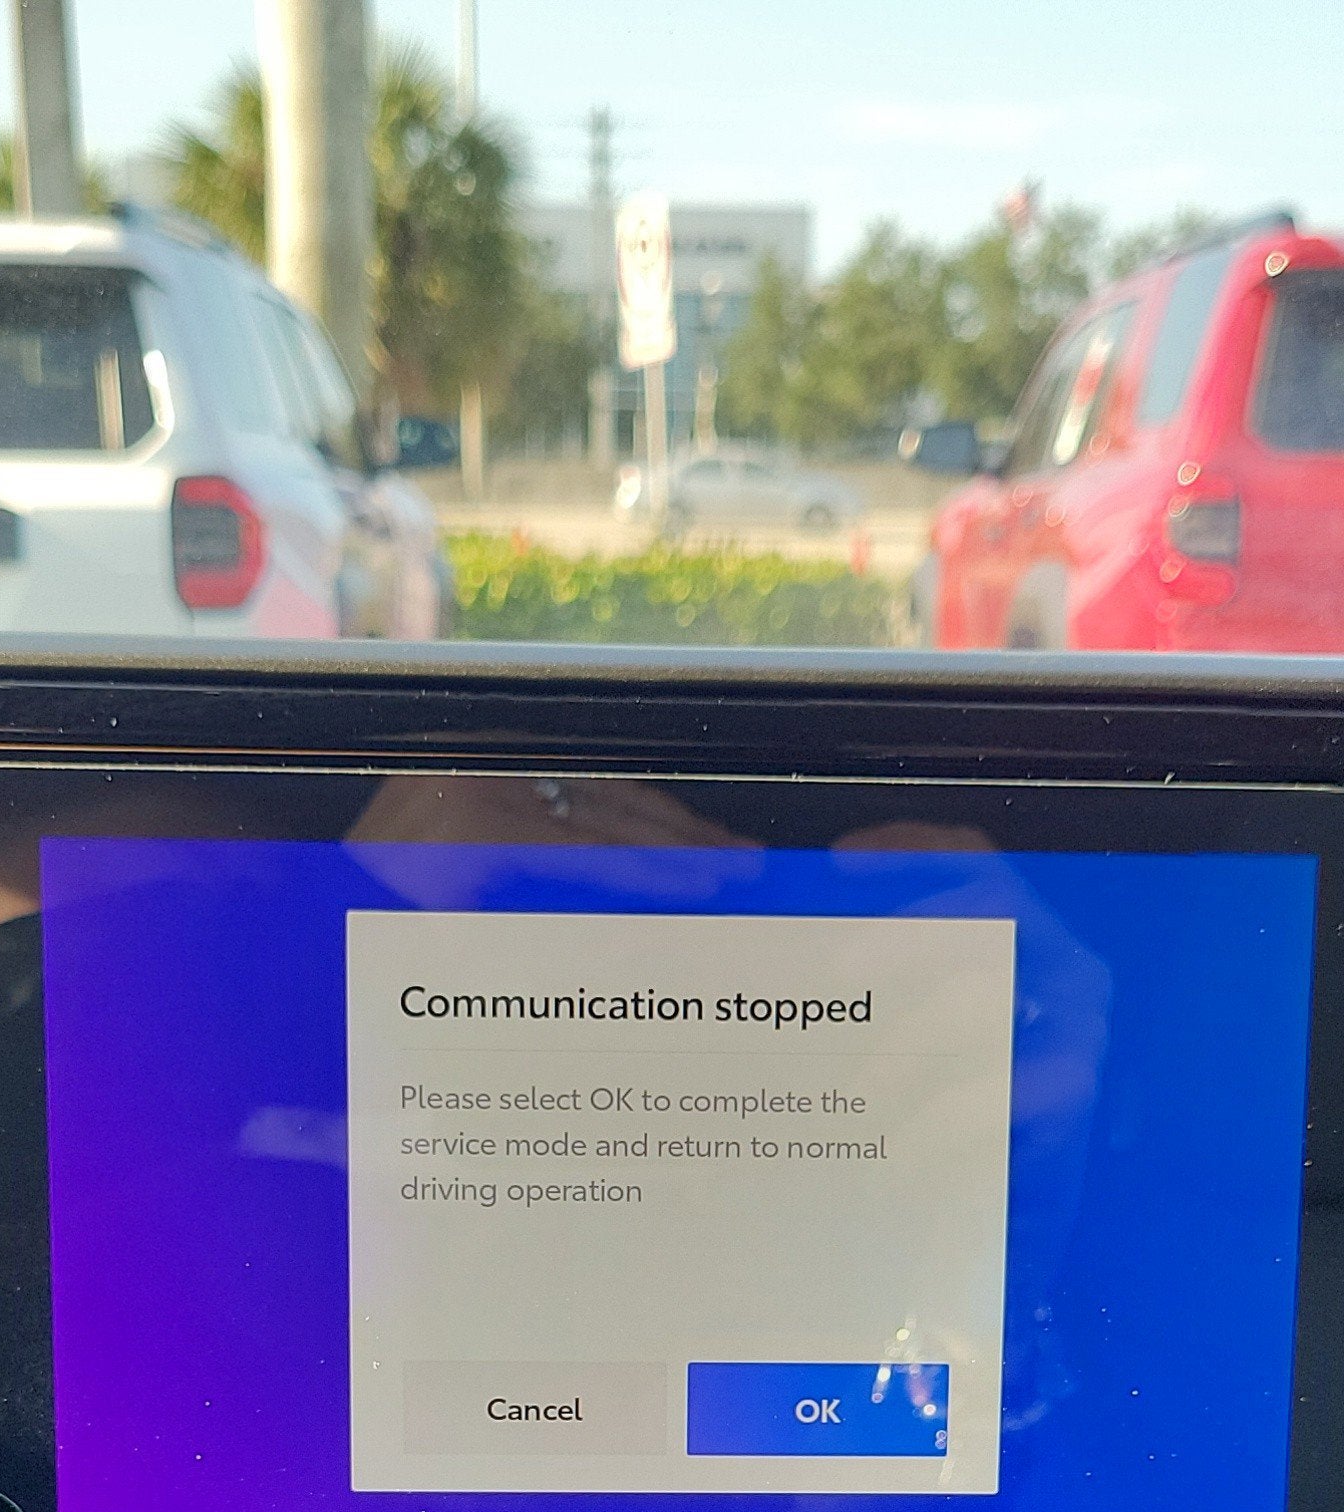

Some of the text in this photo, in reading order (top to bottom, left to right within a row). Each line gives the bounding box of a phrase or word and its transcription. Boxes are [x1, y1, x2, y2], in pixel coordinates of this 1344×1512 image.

[400, 985, 873, 1030] Communication stopped
[400, 1085, 867, 1119] Please select OK to complete the
[400, 1132, 887, 1161] service mode and return to normal
[400, 1176, 643, 1208] driving operation
[486, 1396, 584, 1422] Cancel
[794, 1398, 842, 1425] OK
